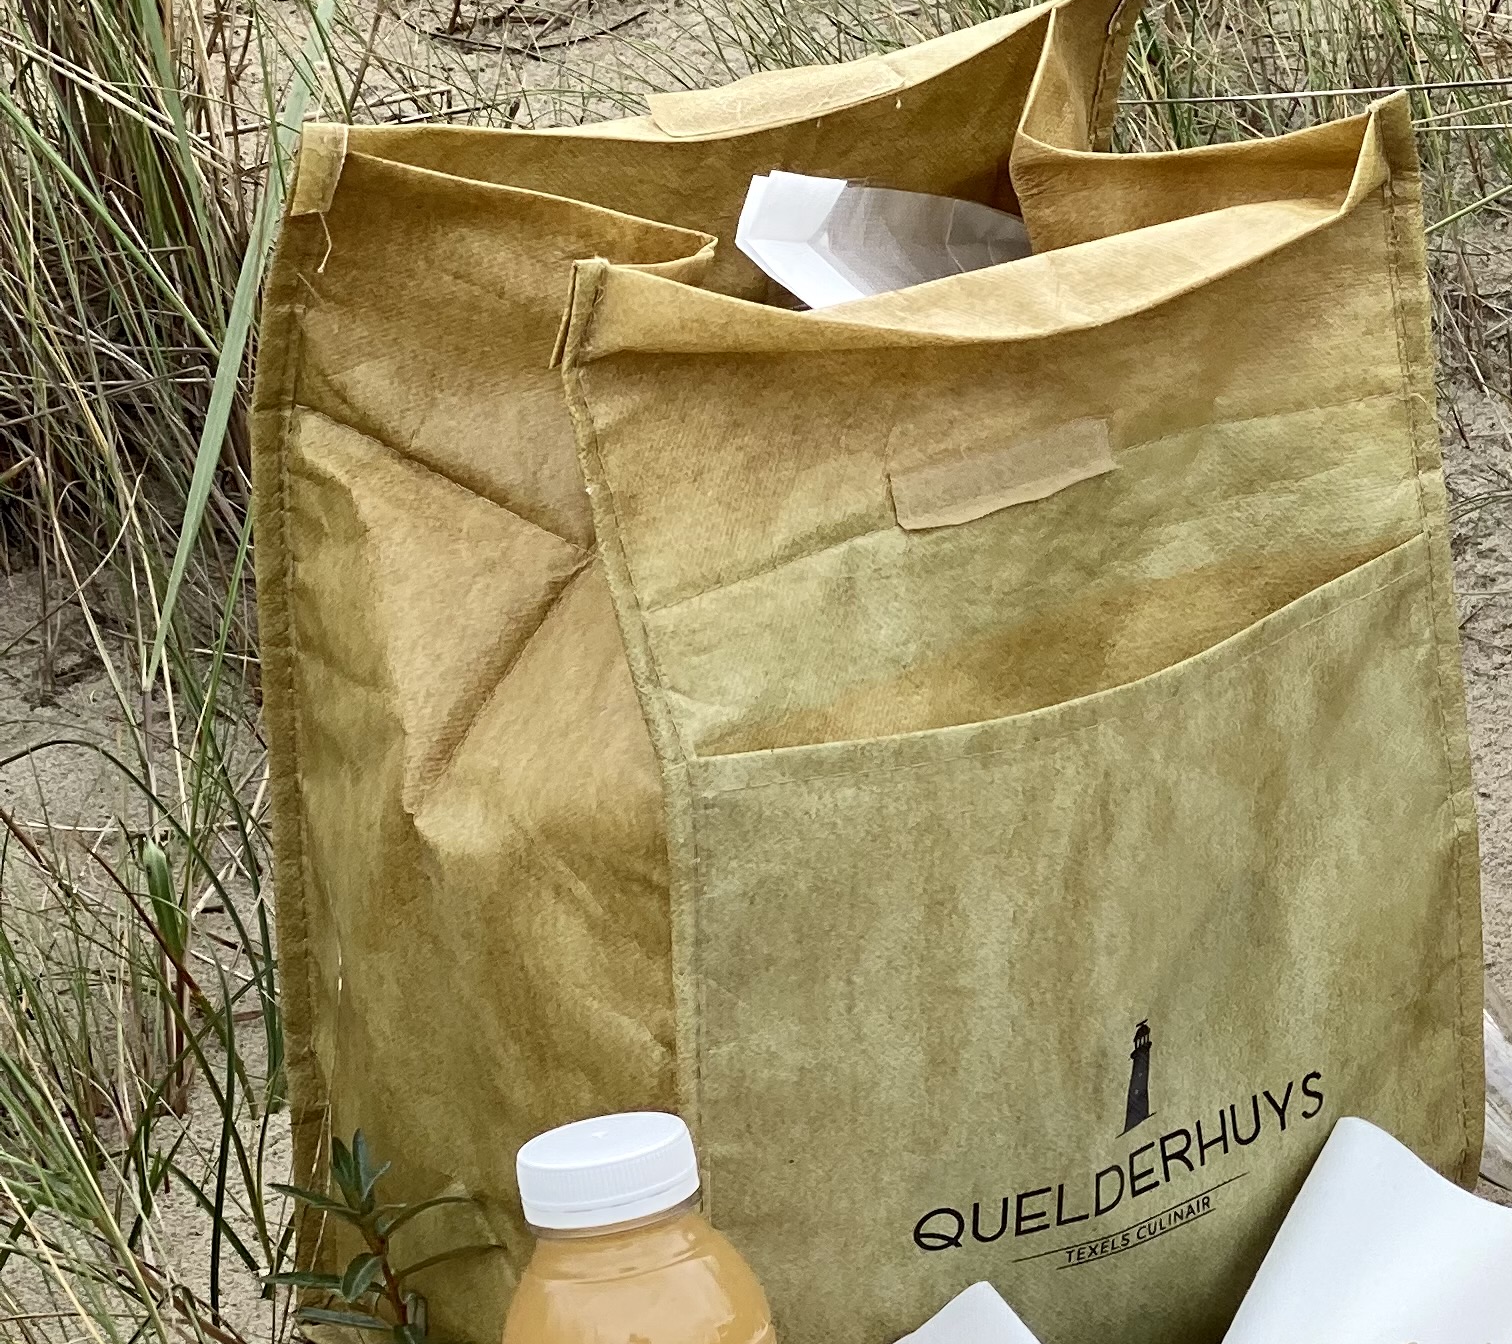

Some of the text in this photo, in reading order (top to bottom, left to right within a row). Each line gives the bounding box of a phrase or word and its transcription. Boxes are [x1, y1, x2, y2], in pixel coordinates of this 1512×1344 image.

[913, 1071, 1325, 1251] QUELDERHUYS
[1066, 1195, 1212, 1265] TEXELS CULINAIR
